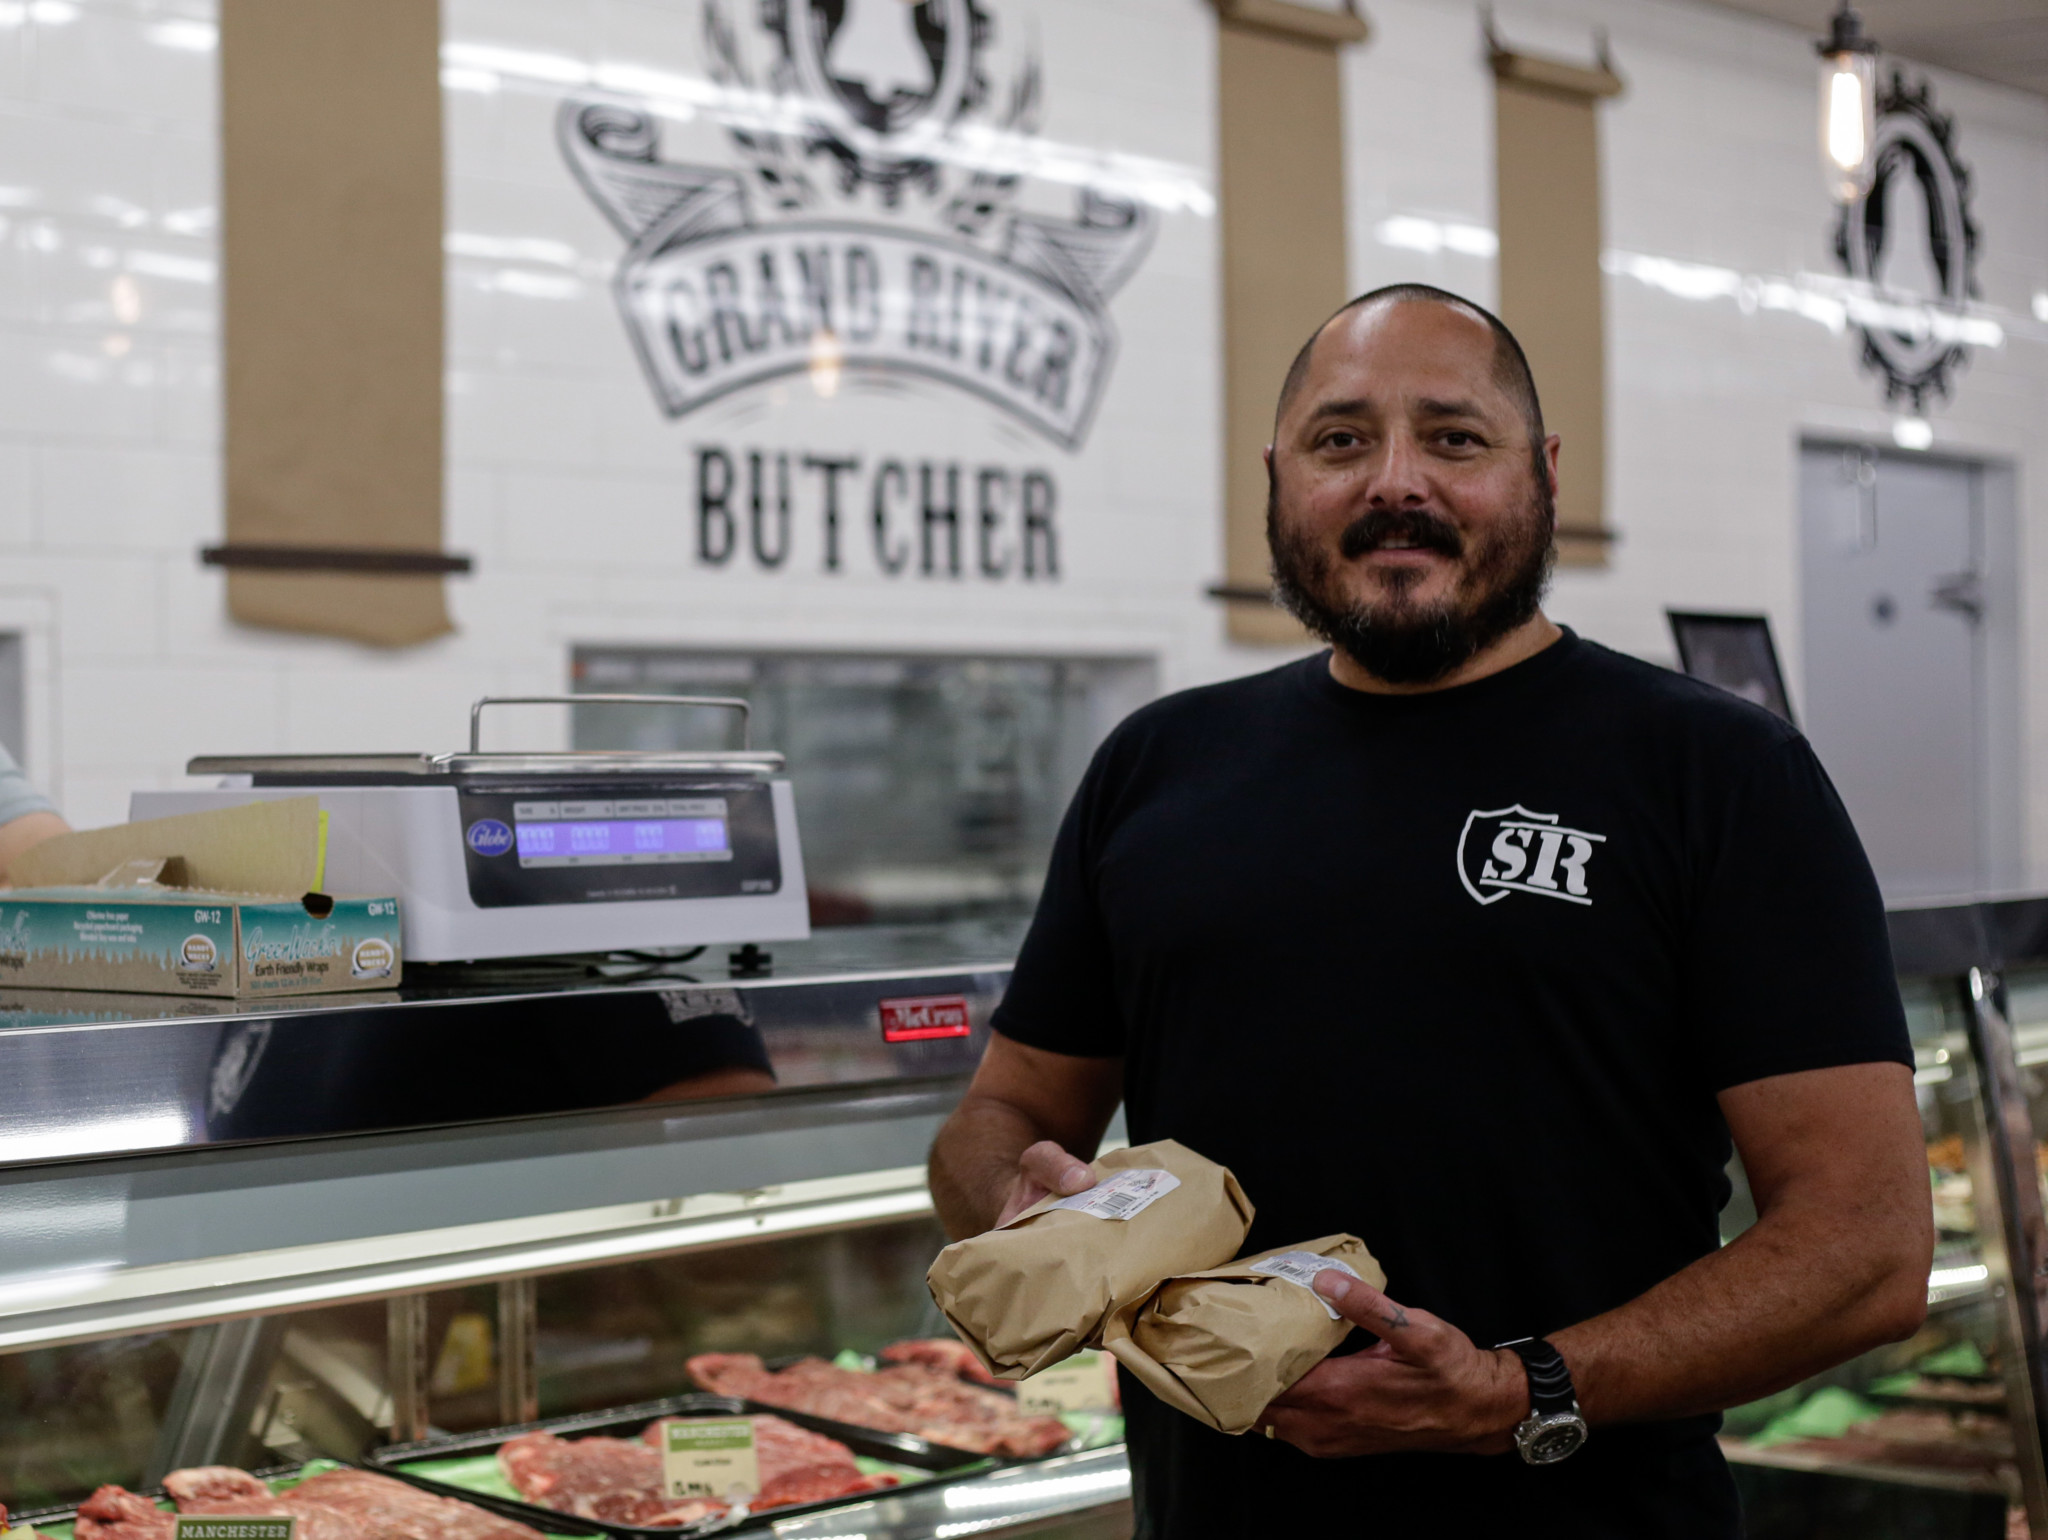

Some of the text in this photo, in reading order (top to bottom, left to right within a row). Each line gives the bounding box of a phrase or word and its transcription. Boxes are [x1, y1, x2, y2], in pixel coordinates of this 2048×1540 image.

[664, 242, 1080, 412] GRAND RIVER
[692, 445, 1061, 580] BUTCHER
[470, 823, 508, 847] Globe
[194, 910, 221, 924] GW-12
[368, 902, 395, 916] GW-12
[255, 961, 330, 977] Earth Friendly Wraps
[181, 1525, 288, 1539] MANCHESTER
